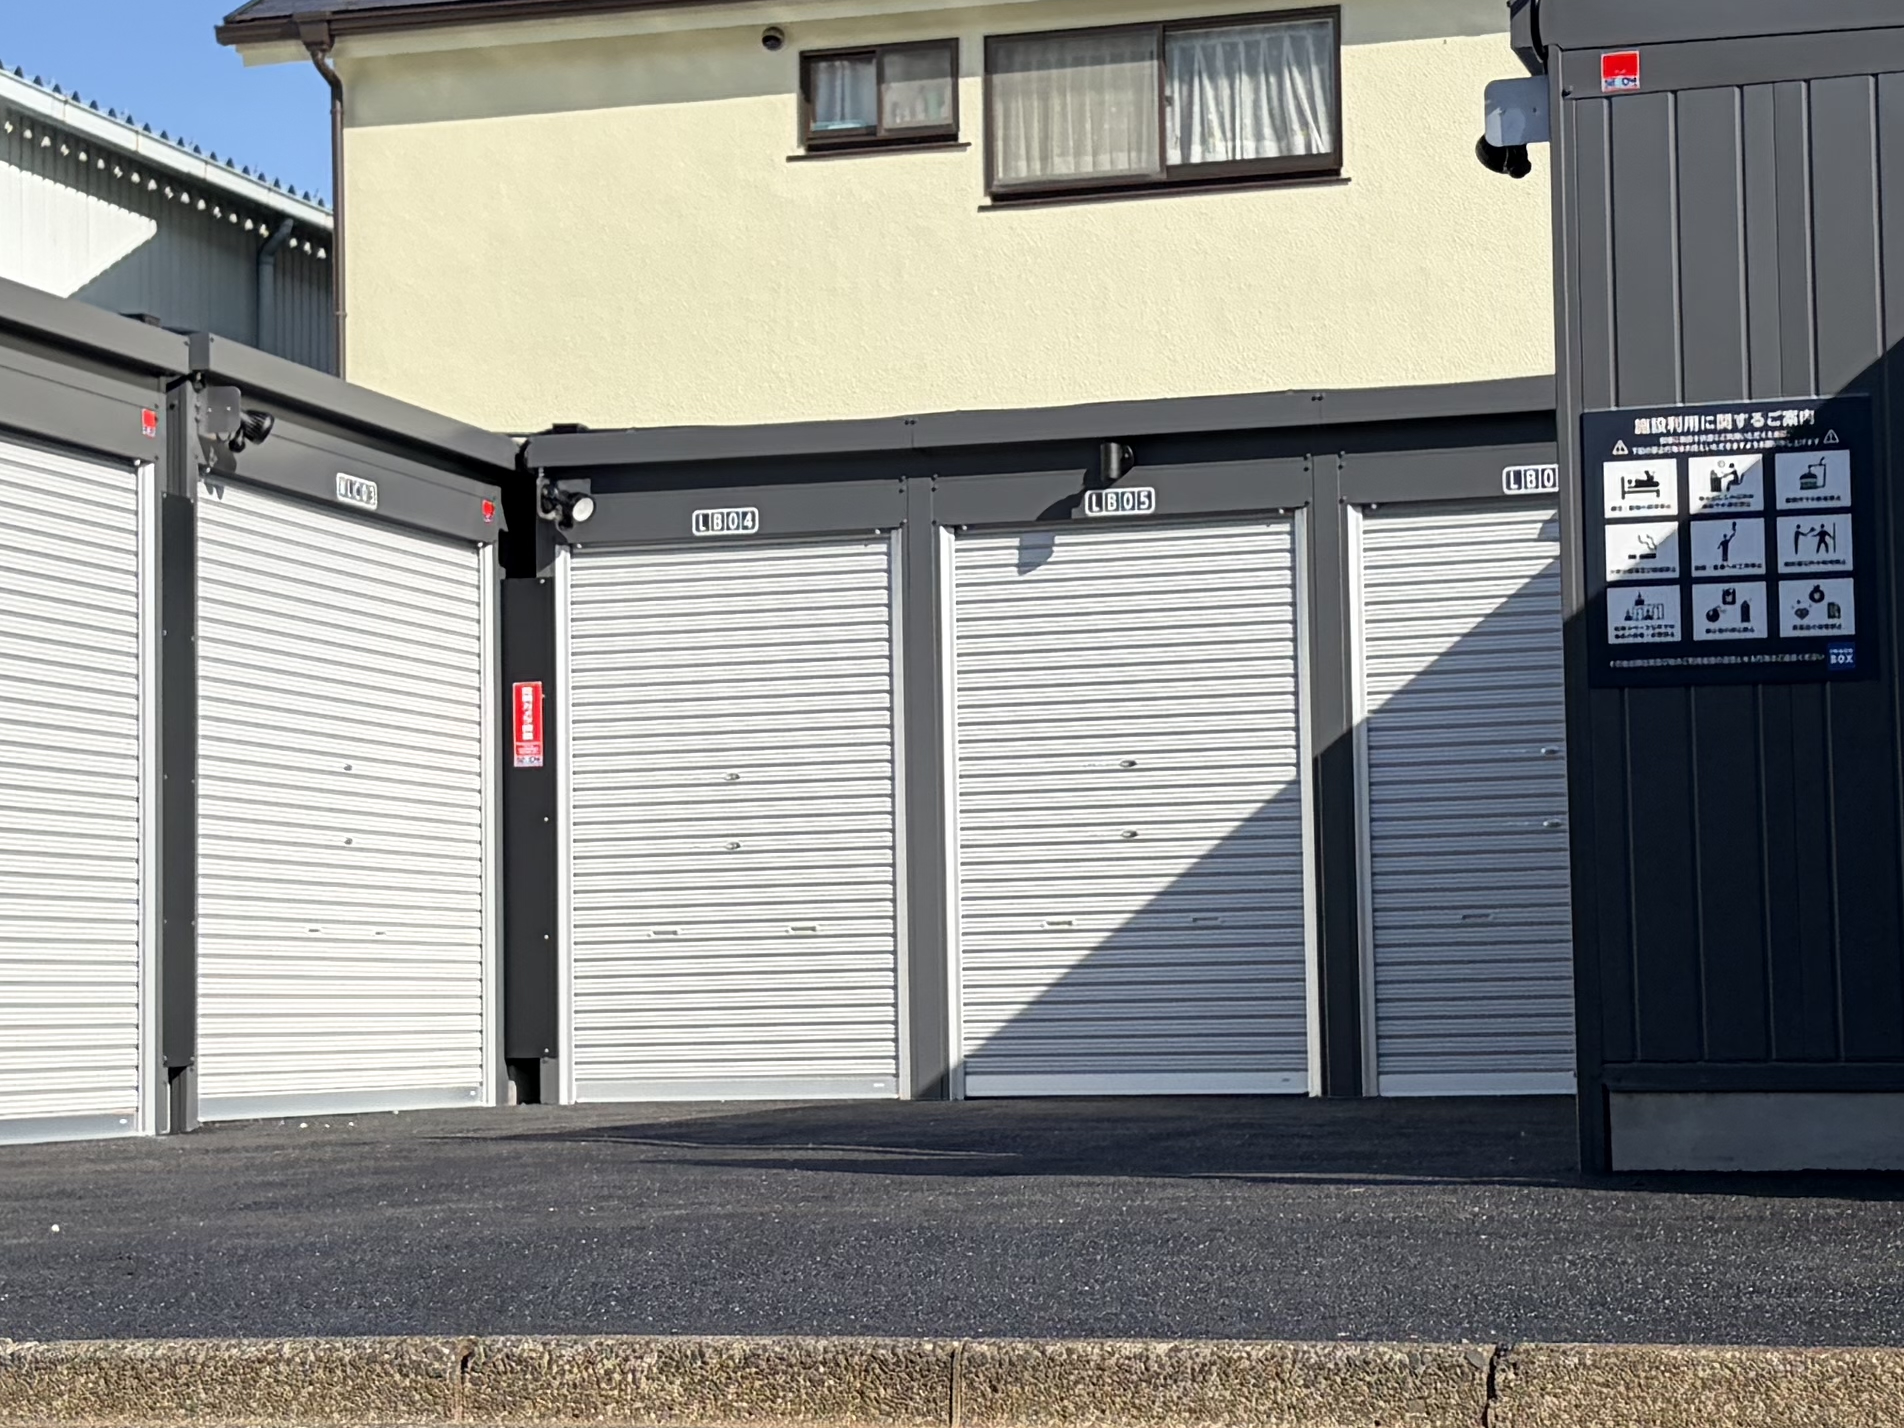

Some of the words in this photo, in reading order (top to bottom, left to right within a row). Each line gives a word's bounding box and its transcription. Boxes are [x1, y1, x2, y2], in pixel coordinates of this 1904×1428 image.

[1634, 409, 1814, 434] 施設利用に関するご案内
[1091, 491, 1149, 512] LB05
[698, 511, 753, 530] LB04
